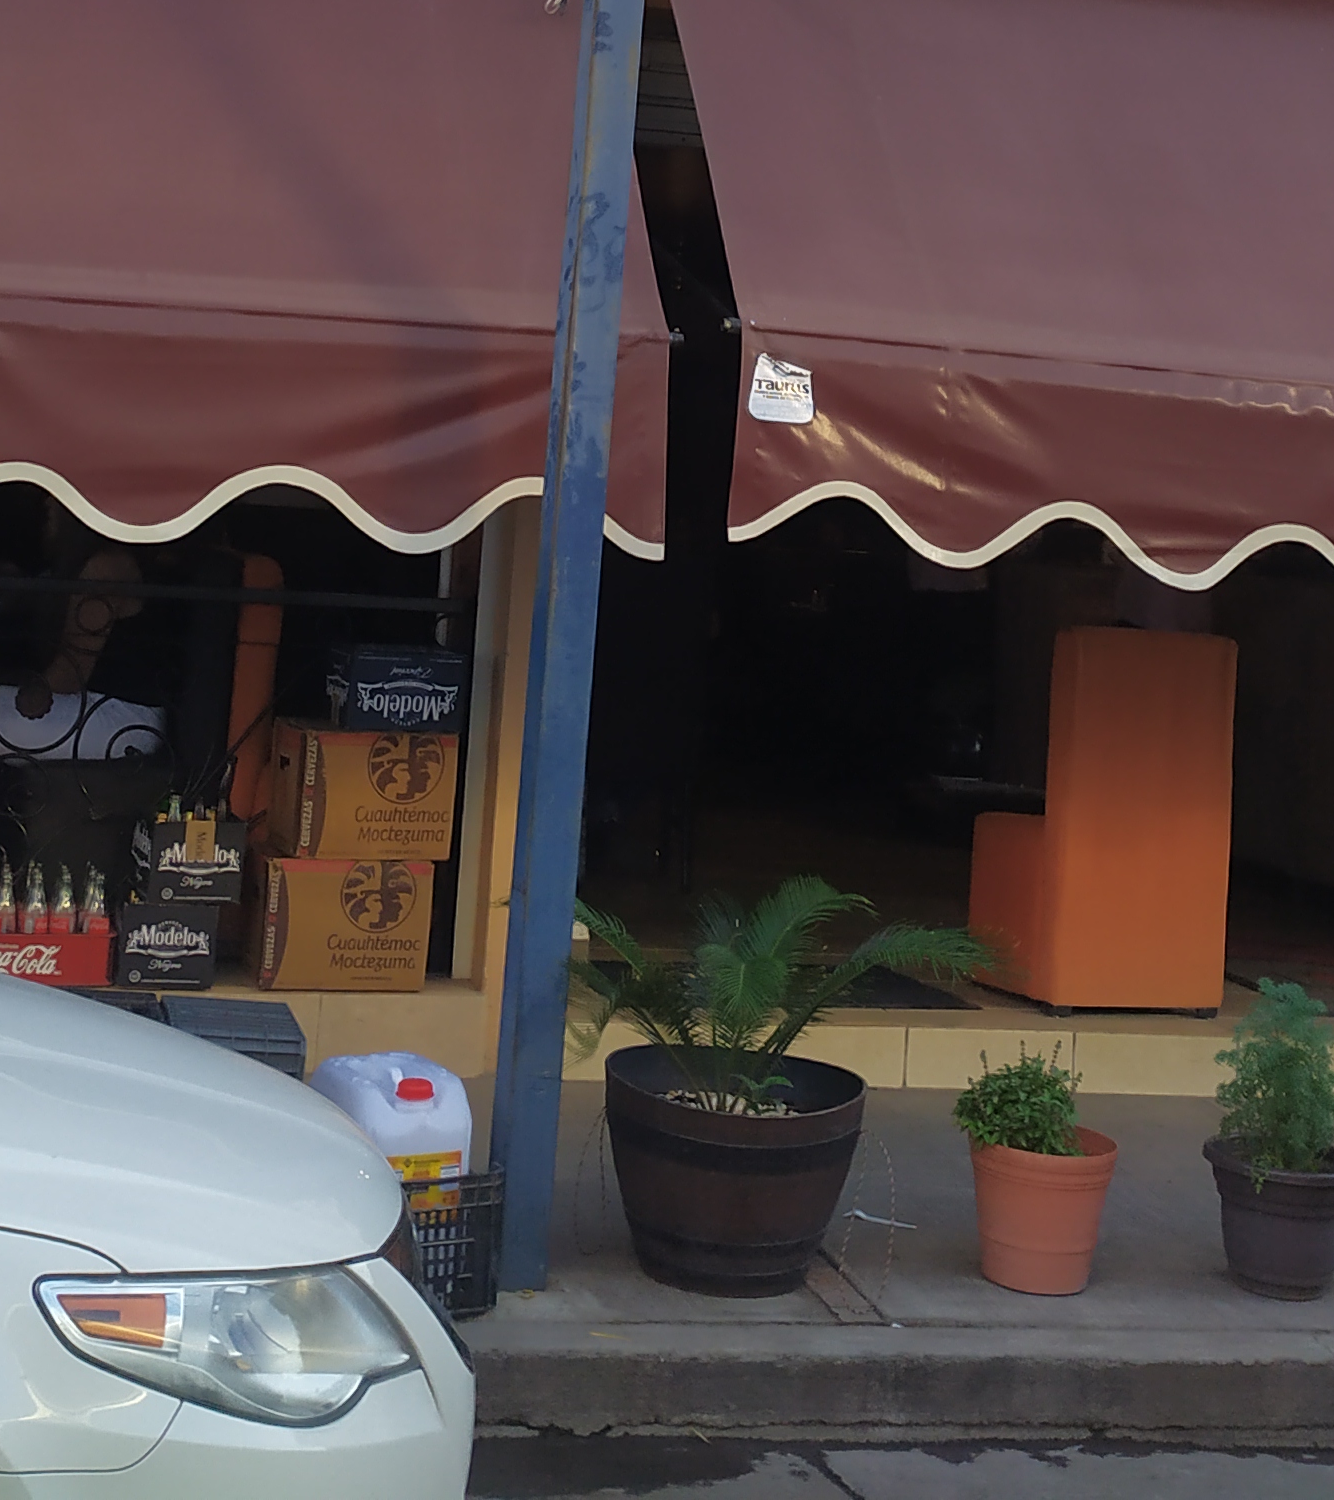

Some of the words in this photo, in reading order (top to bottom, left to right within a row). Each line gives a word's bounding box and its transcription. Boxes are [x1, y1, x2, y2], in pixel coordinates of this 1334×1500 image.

[373, 693, 441, 721] Modelo
[304, 739, 318, 786] CERVEZAS
[299, 800, 314, 847] CERVEZAS
[354, 805, 450, 824] Cuauhtémoc
[357, 826, 445, 846] Moctezuma
[140, 923, 196, 947] Modelo
[263, 925, 276, 969] CERVEZAS
[326, 933, 422, 952] Cuauhtémoc
[329, 953, 416, 972] Moctezuma
